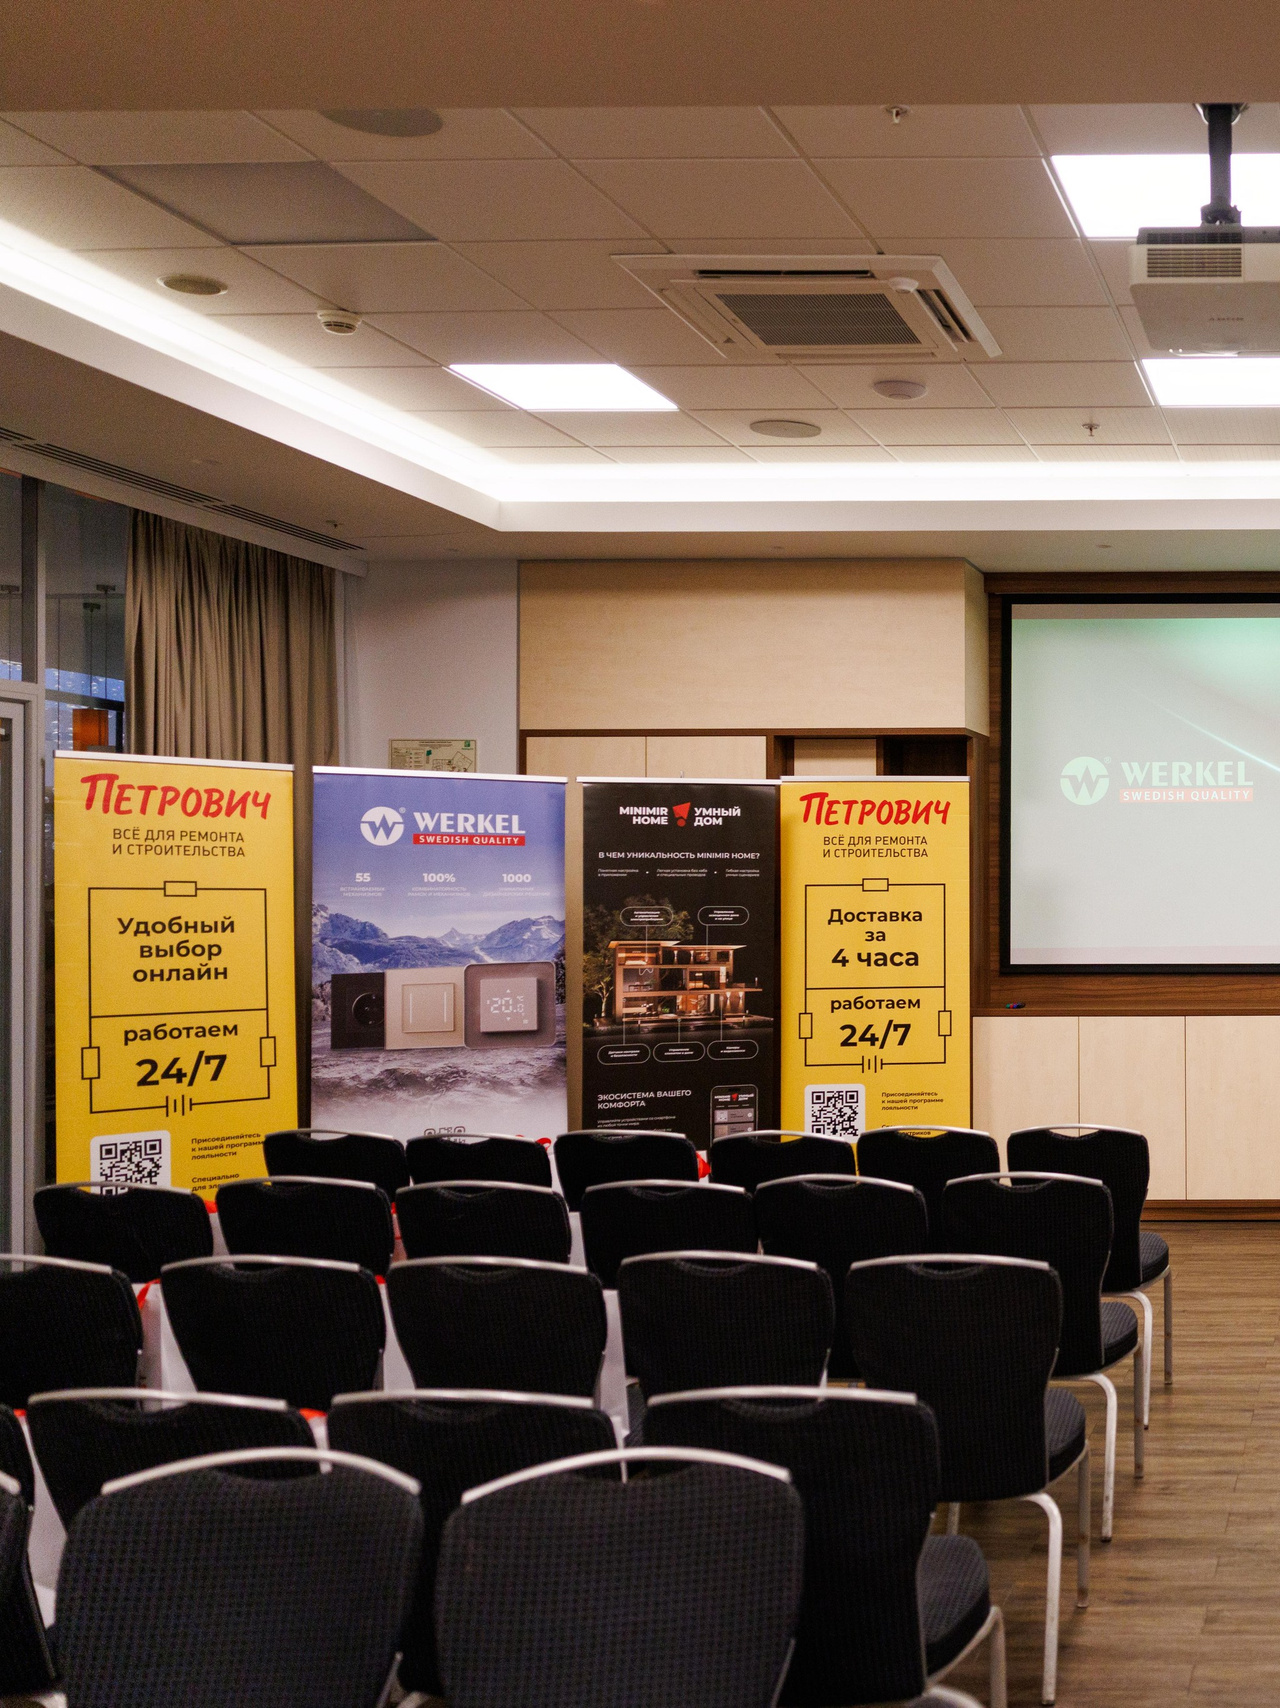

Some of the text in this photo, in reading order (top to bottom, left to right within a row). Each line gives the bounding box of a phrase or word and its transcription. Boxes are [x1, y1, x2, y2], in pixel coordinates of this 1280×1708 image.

[1120, 761, 1254, 787] WERKEL
[80, 773, 272, 820] ПЕТРОВИЧ
[1123, 790, 1250, 801] SWEDISH QUALITY
[619, 806, 668, 815] MINIMIR
[694, 806, 741, 817] УМНЫЙ
[799, 791, 951, 826] ПЕТРОВИЧ
[413, 812, 526, 834] WERKEL
[632, 816, 668, 825] HOME
[693, 817, 723, 827] ДОМ
[113, 827, 245, 843] ВСЁ ДЛЯ РЕМОНТА
[419, 835, 520, 845] SWEDISH QUALITY
[823, 834, 928, 847] ВСЁ ДЛЯ РЕМОНТА
[112, 844, 245, 858] И СТРОИТЕЛЬСТВА
[731, 852, 761, 860] HOME?
[822, 848, 928, 858] И СТРОИТЕЛЬСТВА
[355, 872, 371, 883] 55
[422, 872, 456, 883] 100%
[502, 873, 532, 883] 1000
[827, 908, 923, 925] Доставка
[117, 916, 235, 937] Удобный
[865, 931, 886, 942] за
[139, 939, 223, 961] выбор
[831, 948, 919, 967] 4 часа
[132, 963, 228, 983] онлайн
[830, 995, 921, 1013] работаем
[124, 1023, 239, 1046] работаем
[839, 1019, 912, 1050] 24/7
[135, 1050, 228, 1087] 24/7
[597, 1089, 692, 1102] ЭКОСИСТЕМА ВАШЕГО
[597, 1100, 646, 1110] КОМФОРТА
[191, 1132, 261, 1144] Присоединяйтесь
[198, 1143, 224, 1152] нашей
[226, 1140, 265, 1150] программ
[191, 1151, 237, 1161] лояльности
[191, 1173, 240, 1183] Специально
[191, 1184, 207, 1193] для
